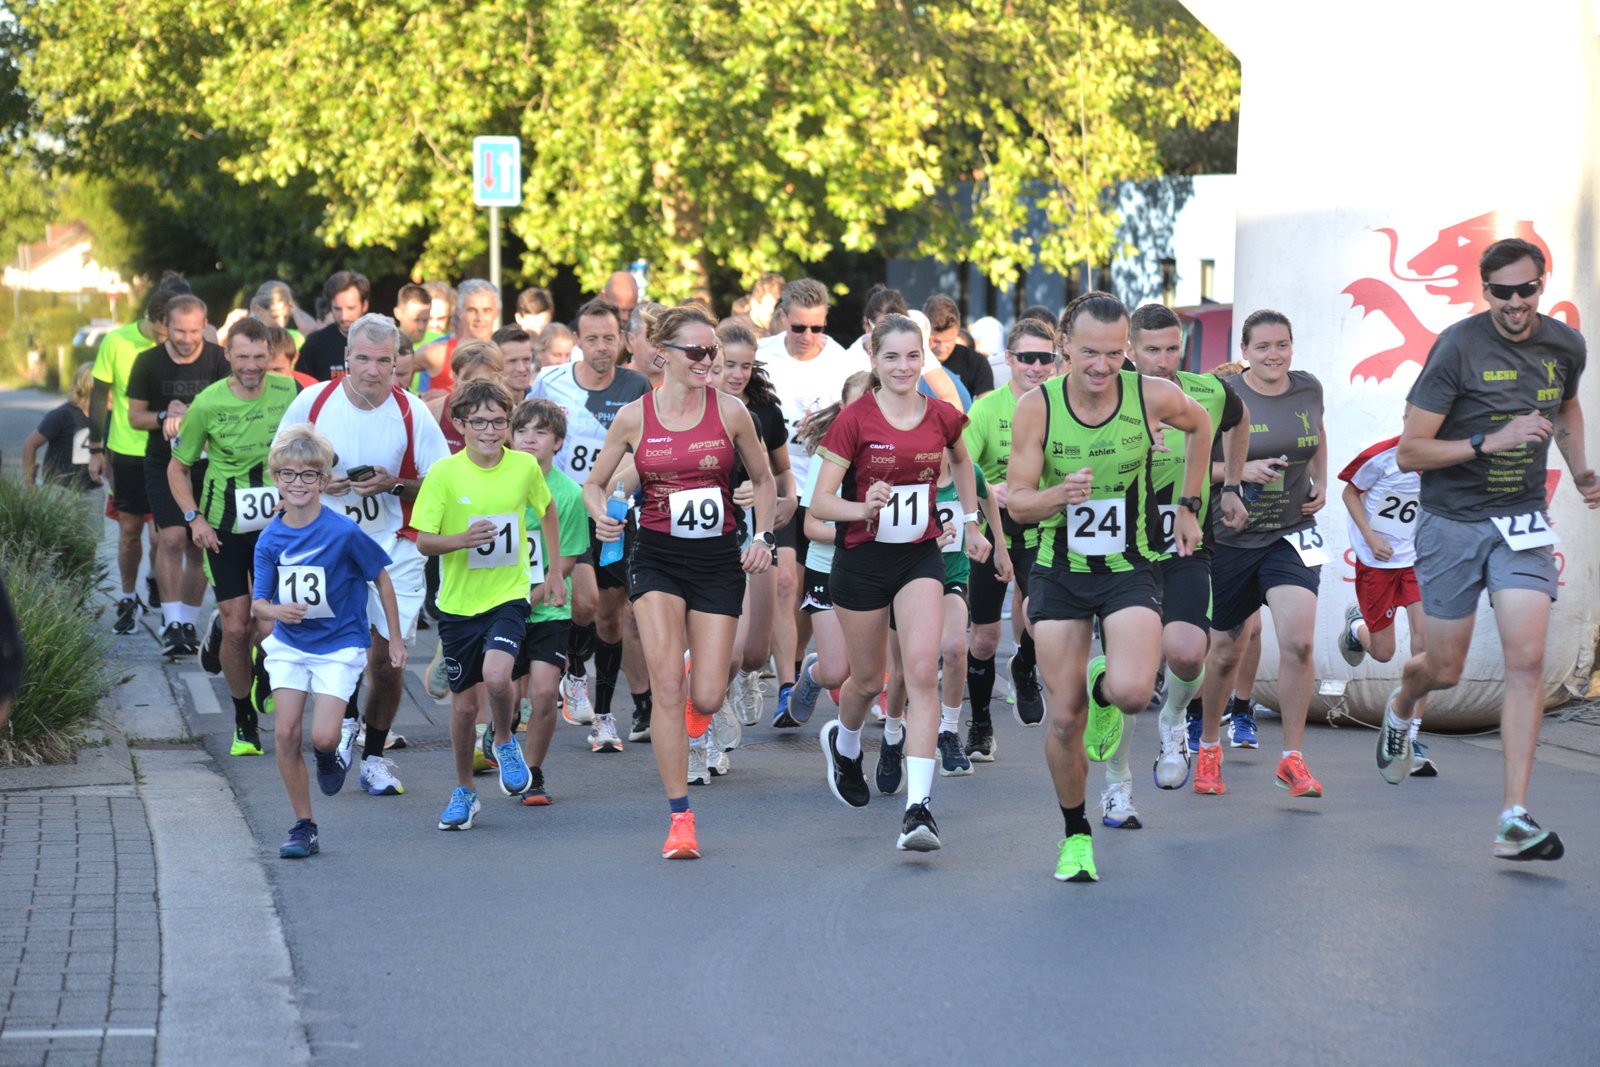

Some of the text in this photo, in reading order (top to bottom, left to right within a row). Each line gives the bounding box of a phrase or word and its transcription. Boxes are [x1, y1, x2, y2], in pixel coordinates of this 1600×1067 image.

[1483, 370, 1517, 381] GLENN
[688, 439, 726, 451] MPOWR
[1088, 448, 1116, 457] Athlex
[1297, 435, 1319, 448] RTB
[242, 492, 276, 520] 30
[676, 498, 719, 531] 49
[886, 491, 918, 527] 11
[1378, 496, 1418, 524] 26
[1074, 505, 1121, 538] 24
[1289, 527, 1323, 551] 23
[285, 572, 321, 606] 13
